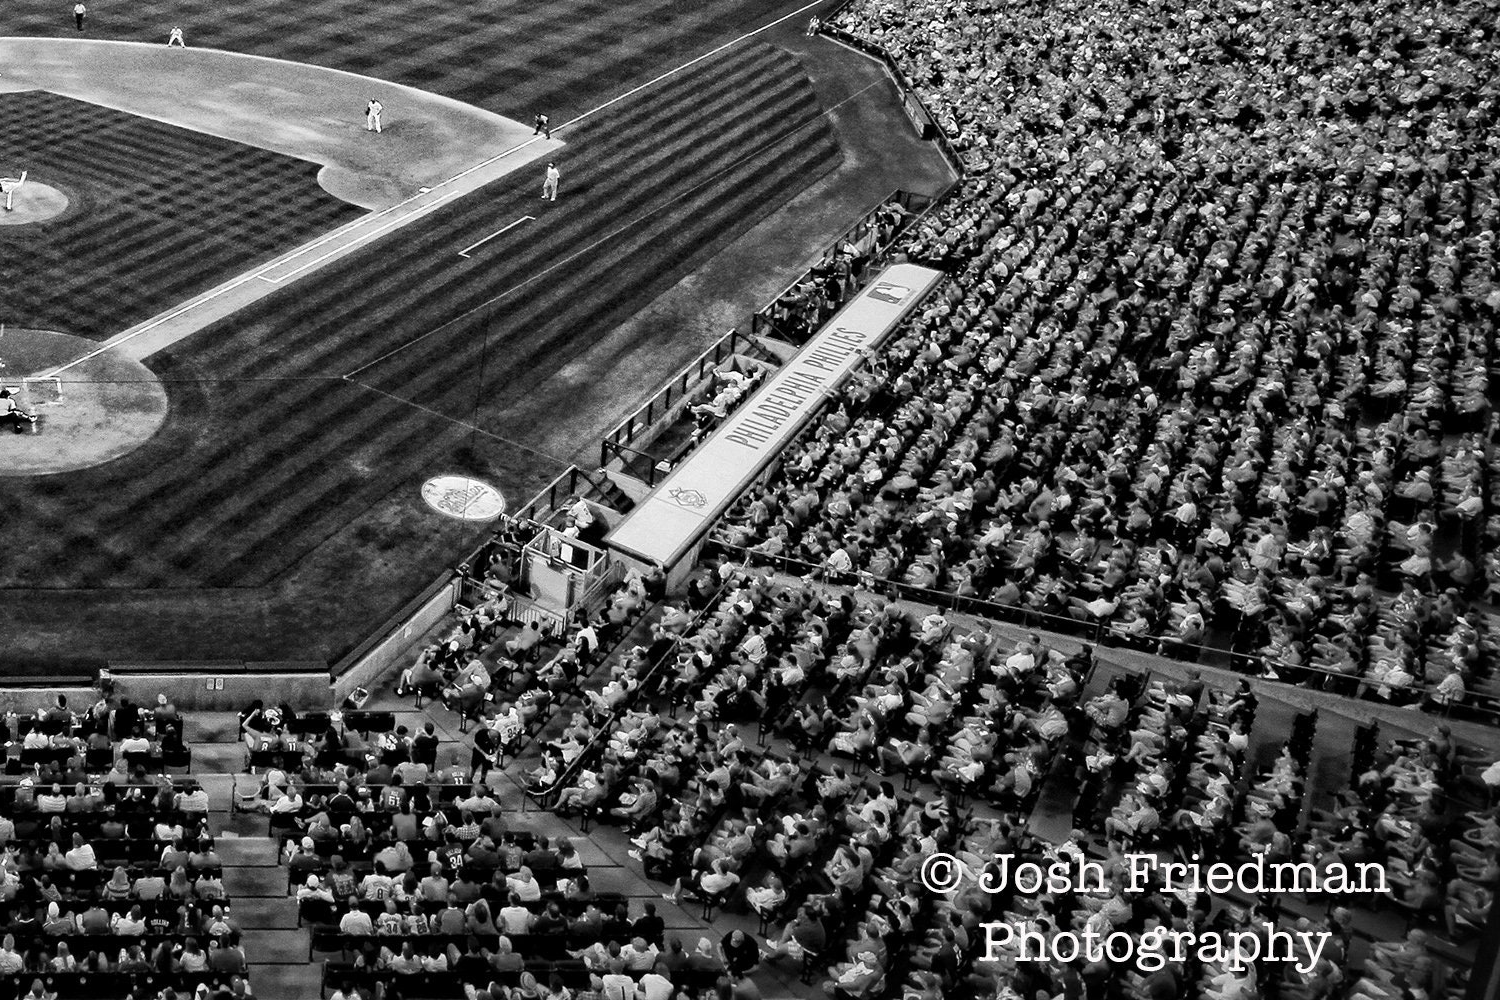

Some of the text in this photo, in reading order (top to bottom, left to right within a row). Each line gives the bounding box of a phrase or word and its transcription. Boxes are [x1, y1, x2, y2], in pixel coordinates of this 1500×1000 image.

[725, 327, 867, 450] PHILADELPHIA PHILLIES
[261, 742, 269, 751] 8
[450, 855, 464, 869] 34
[386, 922, 398, 934] 34
